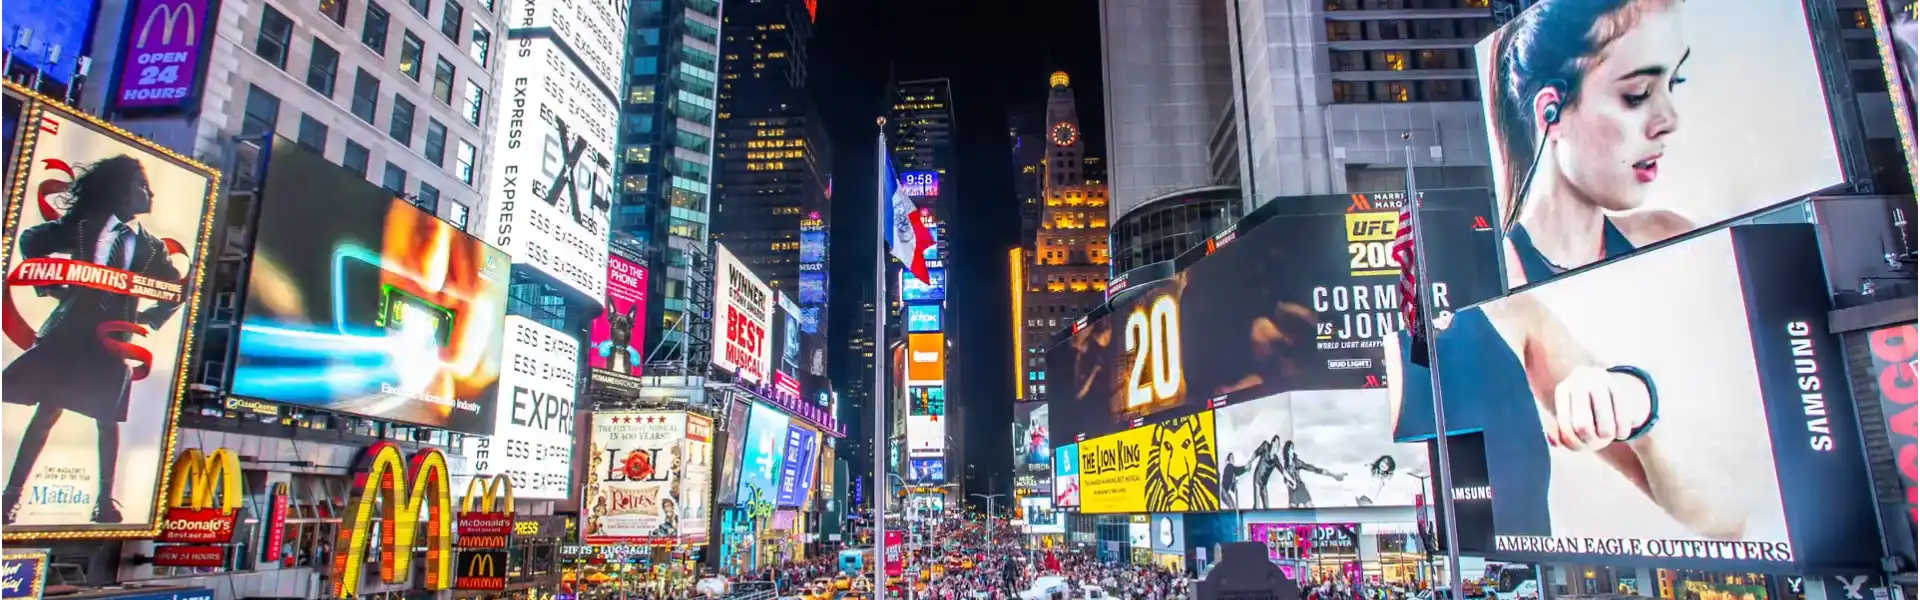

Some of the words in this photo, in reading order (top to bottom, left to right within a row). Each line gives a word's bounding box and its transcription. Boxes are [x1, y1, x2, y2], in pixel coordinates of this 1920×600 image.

[137, 51, 189, 65] OPEN
[138, 65, 179, 86] 24
[123, 87, 188, 101] HOURS
[508, 77, 528, 149] EXPRESS
[906, 174, 933, 185] 9:58
[497, 165, 519, 247] EXPRESS
[1216, 224, 1238, 240] MARRIOTT
[1352, 219, 1395, 236] UFC
[19, 261, 64, 282] FINAL
[66, 263, 128, 290] MONTHS
[611, 269, 638, 288] PHONE
[629, 265, 644, 280] THE
[132, 274, 149, 286] SEE
[155, 280, 183, 294] BEFORE
[728, 263, 767, 312] WINNER!
[130, 284, 176, 300] JANUARY
[176, 293, 181, 302] 1
[1313, 283, 1450, 313] CORMR
[727, 303, 765, 359] BEST
[1316, 322, 1333, 336] VS
[1341, 341, 1360, 349] LIGHT
[1347, 360, 1370, 368] LIGHT
[1787, 321, 1834, 452] SAMSUNG
[455, 397, 480, 414] Industry
[789, 393, 838, 431] BROADWAY
[609, 432, 619, 440] IN
[621, 432, 637, 440] 400
[1082, 452, 1096, 474] THE
[1097, 445, 1116, 475] LION
[1117, 440, 1140, 472] KING
[27, 484, 90, 505] Matilda
[162, 518, 231, 532] McDonald's
[459, 518, 511, 527] McDonald's
[167, 531, 217, 539] Restaurant
[191, 552, 220, 561] HOURS
[1498, 535, 1579, 553] AMERICAN
[1584, 537, 1643, 556] EAGLE
[1647, 538, 1792, 561] OUTFITTERS
